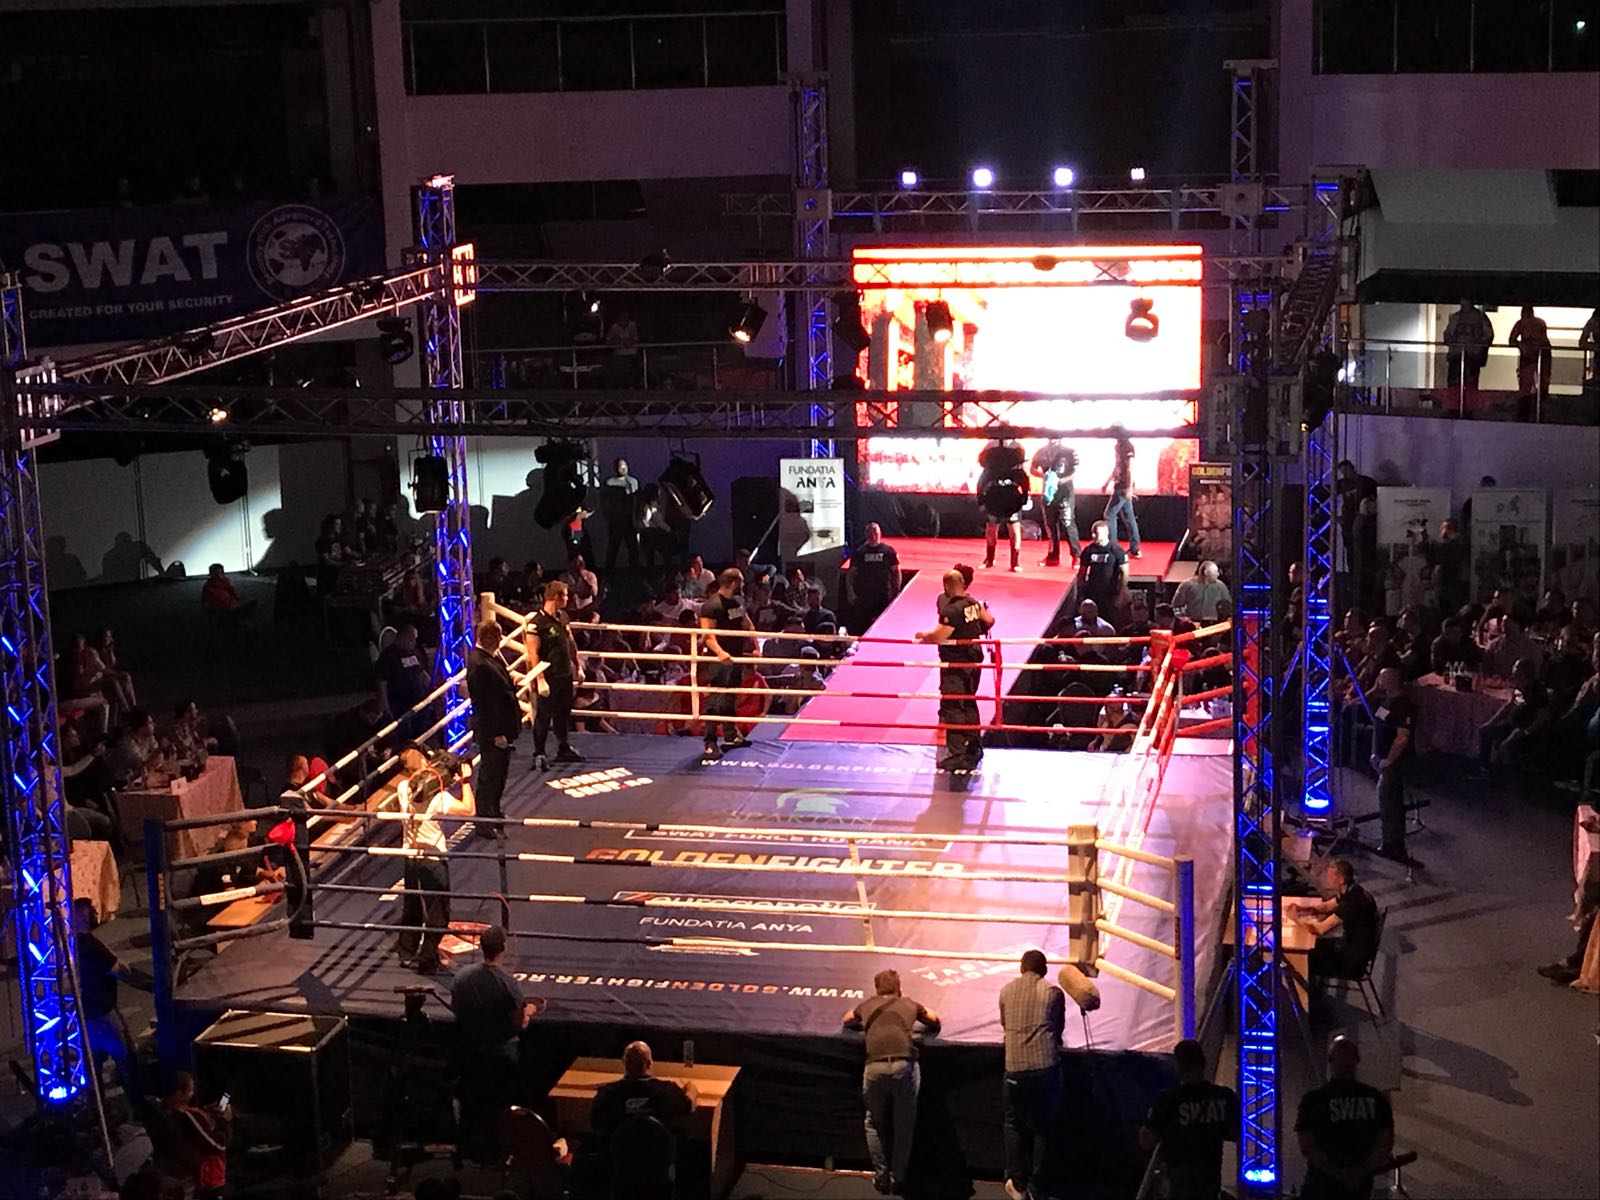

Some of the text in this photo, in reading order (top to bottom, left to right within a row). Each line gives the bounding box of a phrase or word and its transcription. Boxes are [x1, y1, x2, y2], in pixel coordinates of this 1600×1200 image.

[24, 231, 228, 293] SWAT
[29, 294, 234, 320] CREATED FOR YOUR SECURITY
[788, 465, 835, 475] FUNDATIA
[639, 916, 813, 933] FUNDATIA ANYA
[1178, 1099, 1228, 1127] SWAT
[1328, 1096, 1377, 1124] SWAT
